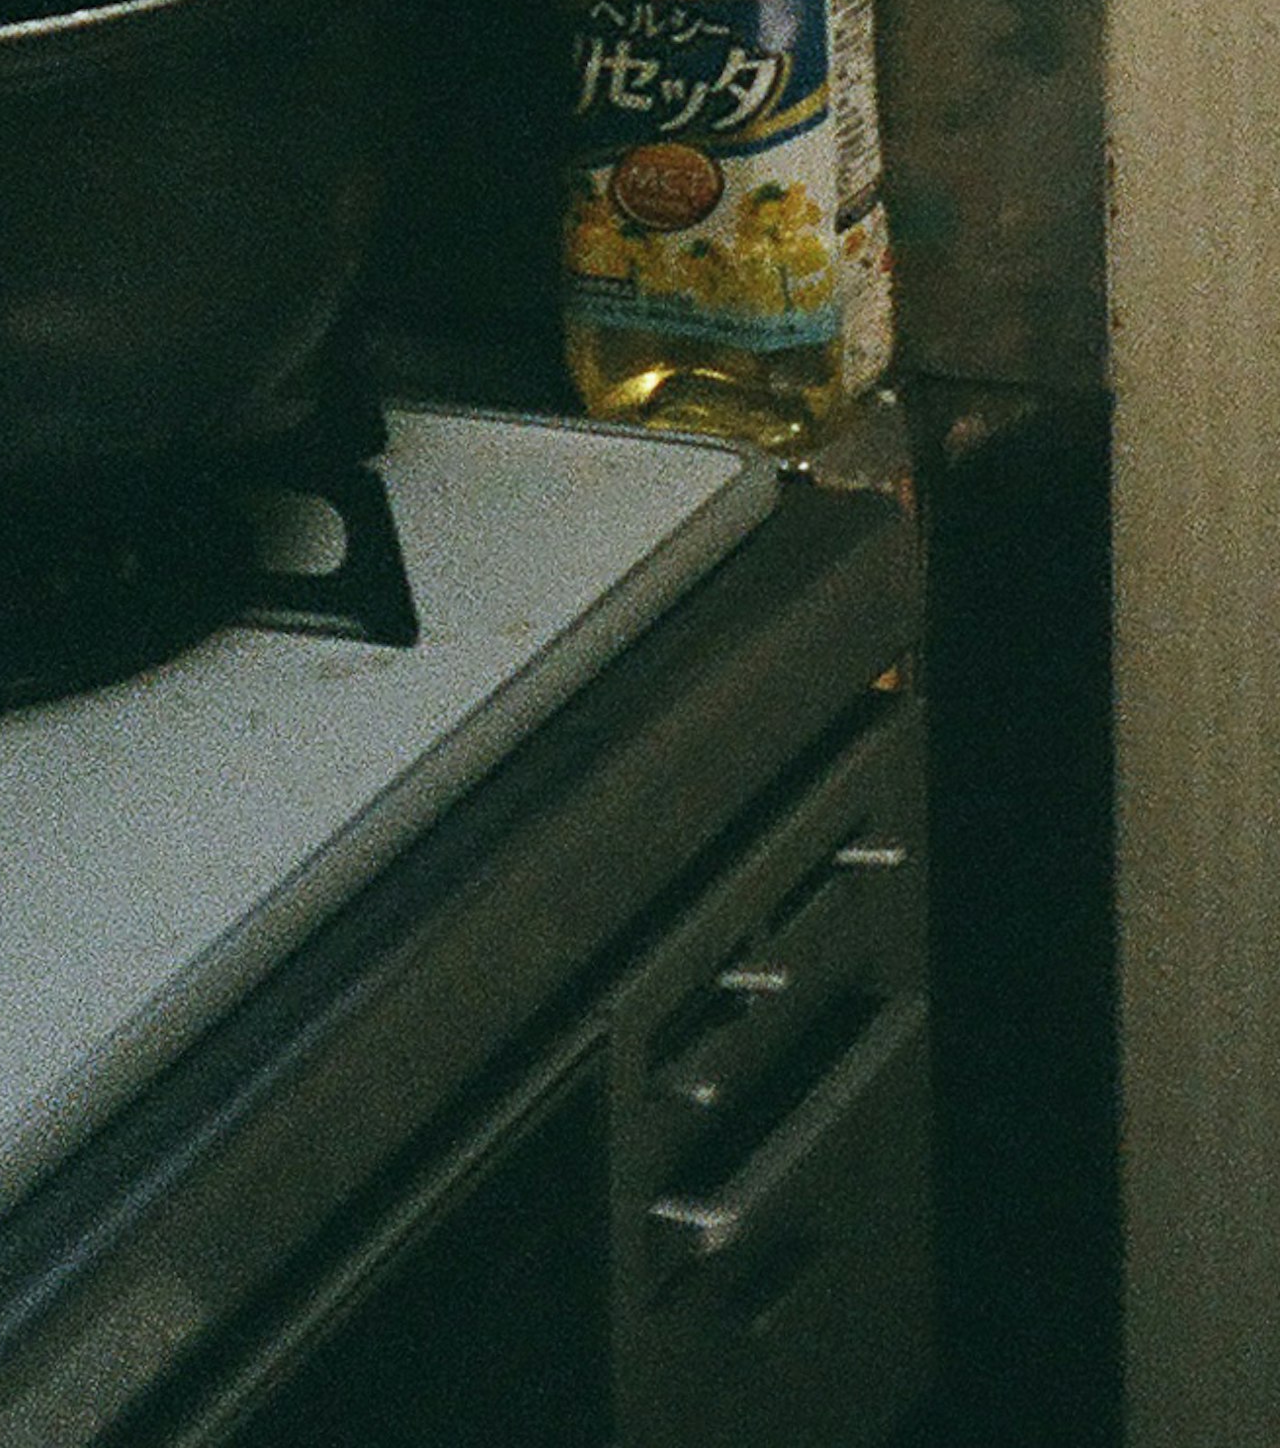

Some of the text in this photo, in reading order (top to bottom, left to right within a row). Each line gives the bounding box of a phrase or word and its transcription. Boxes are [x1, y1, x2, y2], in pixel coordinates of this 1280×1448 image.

[589, 0, 731, 44] ヘルシー
[574, 35, 777, 131] リセッタ
